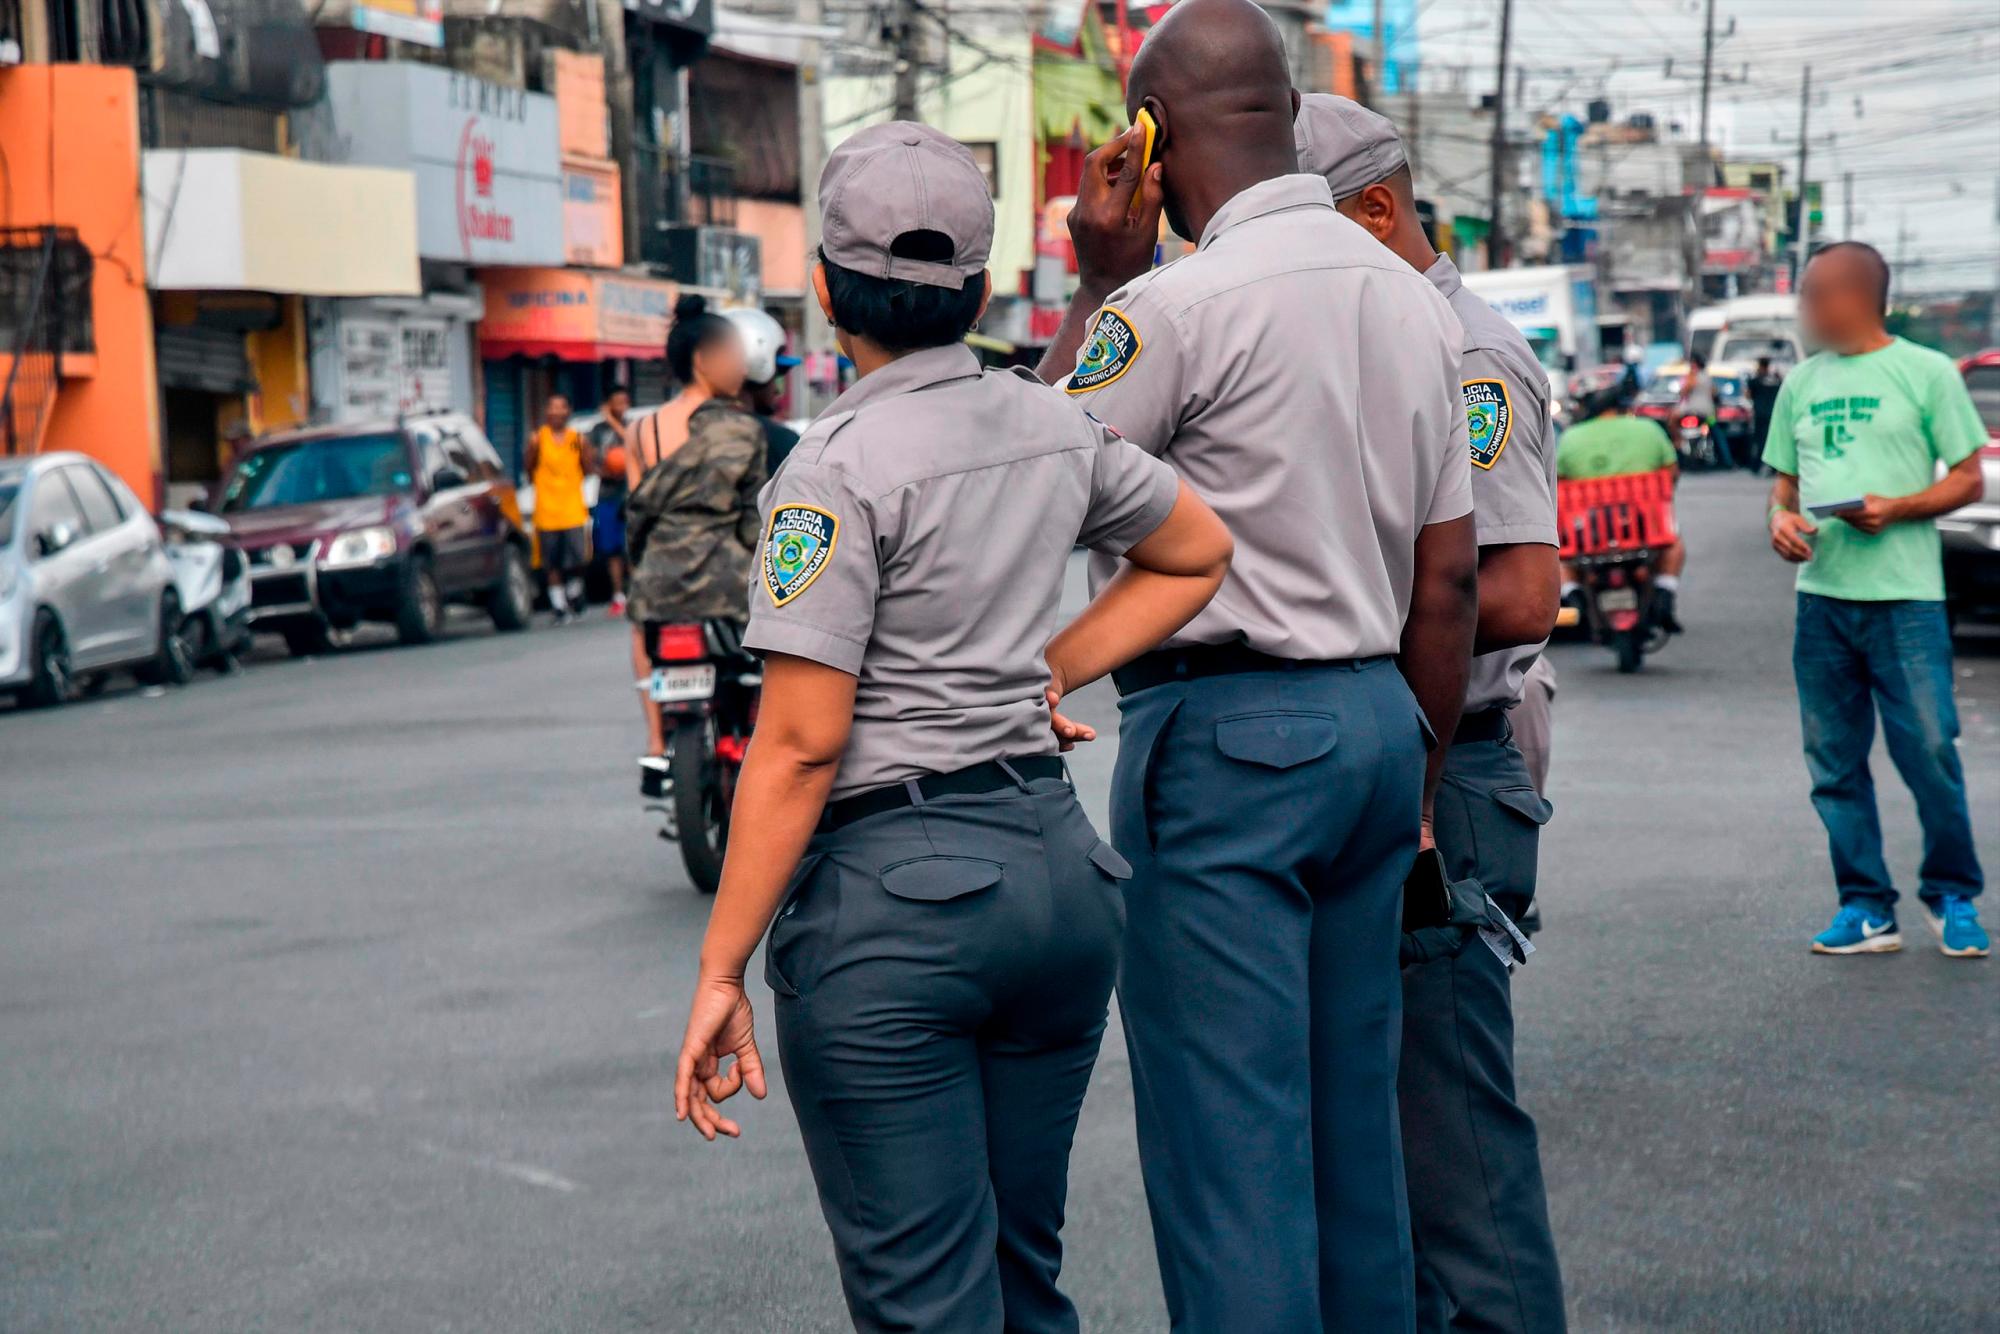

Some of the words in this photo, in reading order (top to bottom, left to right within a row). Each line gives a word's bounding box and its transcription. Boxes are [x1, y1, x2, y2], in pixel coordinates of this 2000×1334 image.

[1077, 361, 1124, 386] DOMINICANA
[1464, 392, 1502, 406] IONAL
[1487, 405, 1508, 457] DOMINICANA
[781, 509, 823, 527] POLICIA
[773, 520, 828, 541] NACIONAL
[784, 546, 829, 596] DOMINICANA
